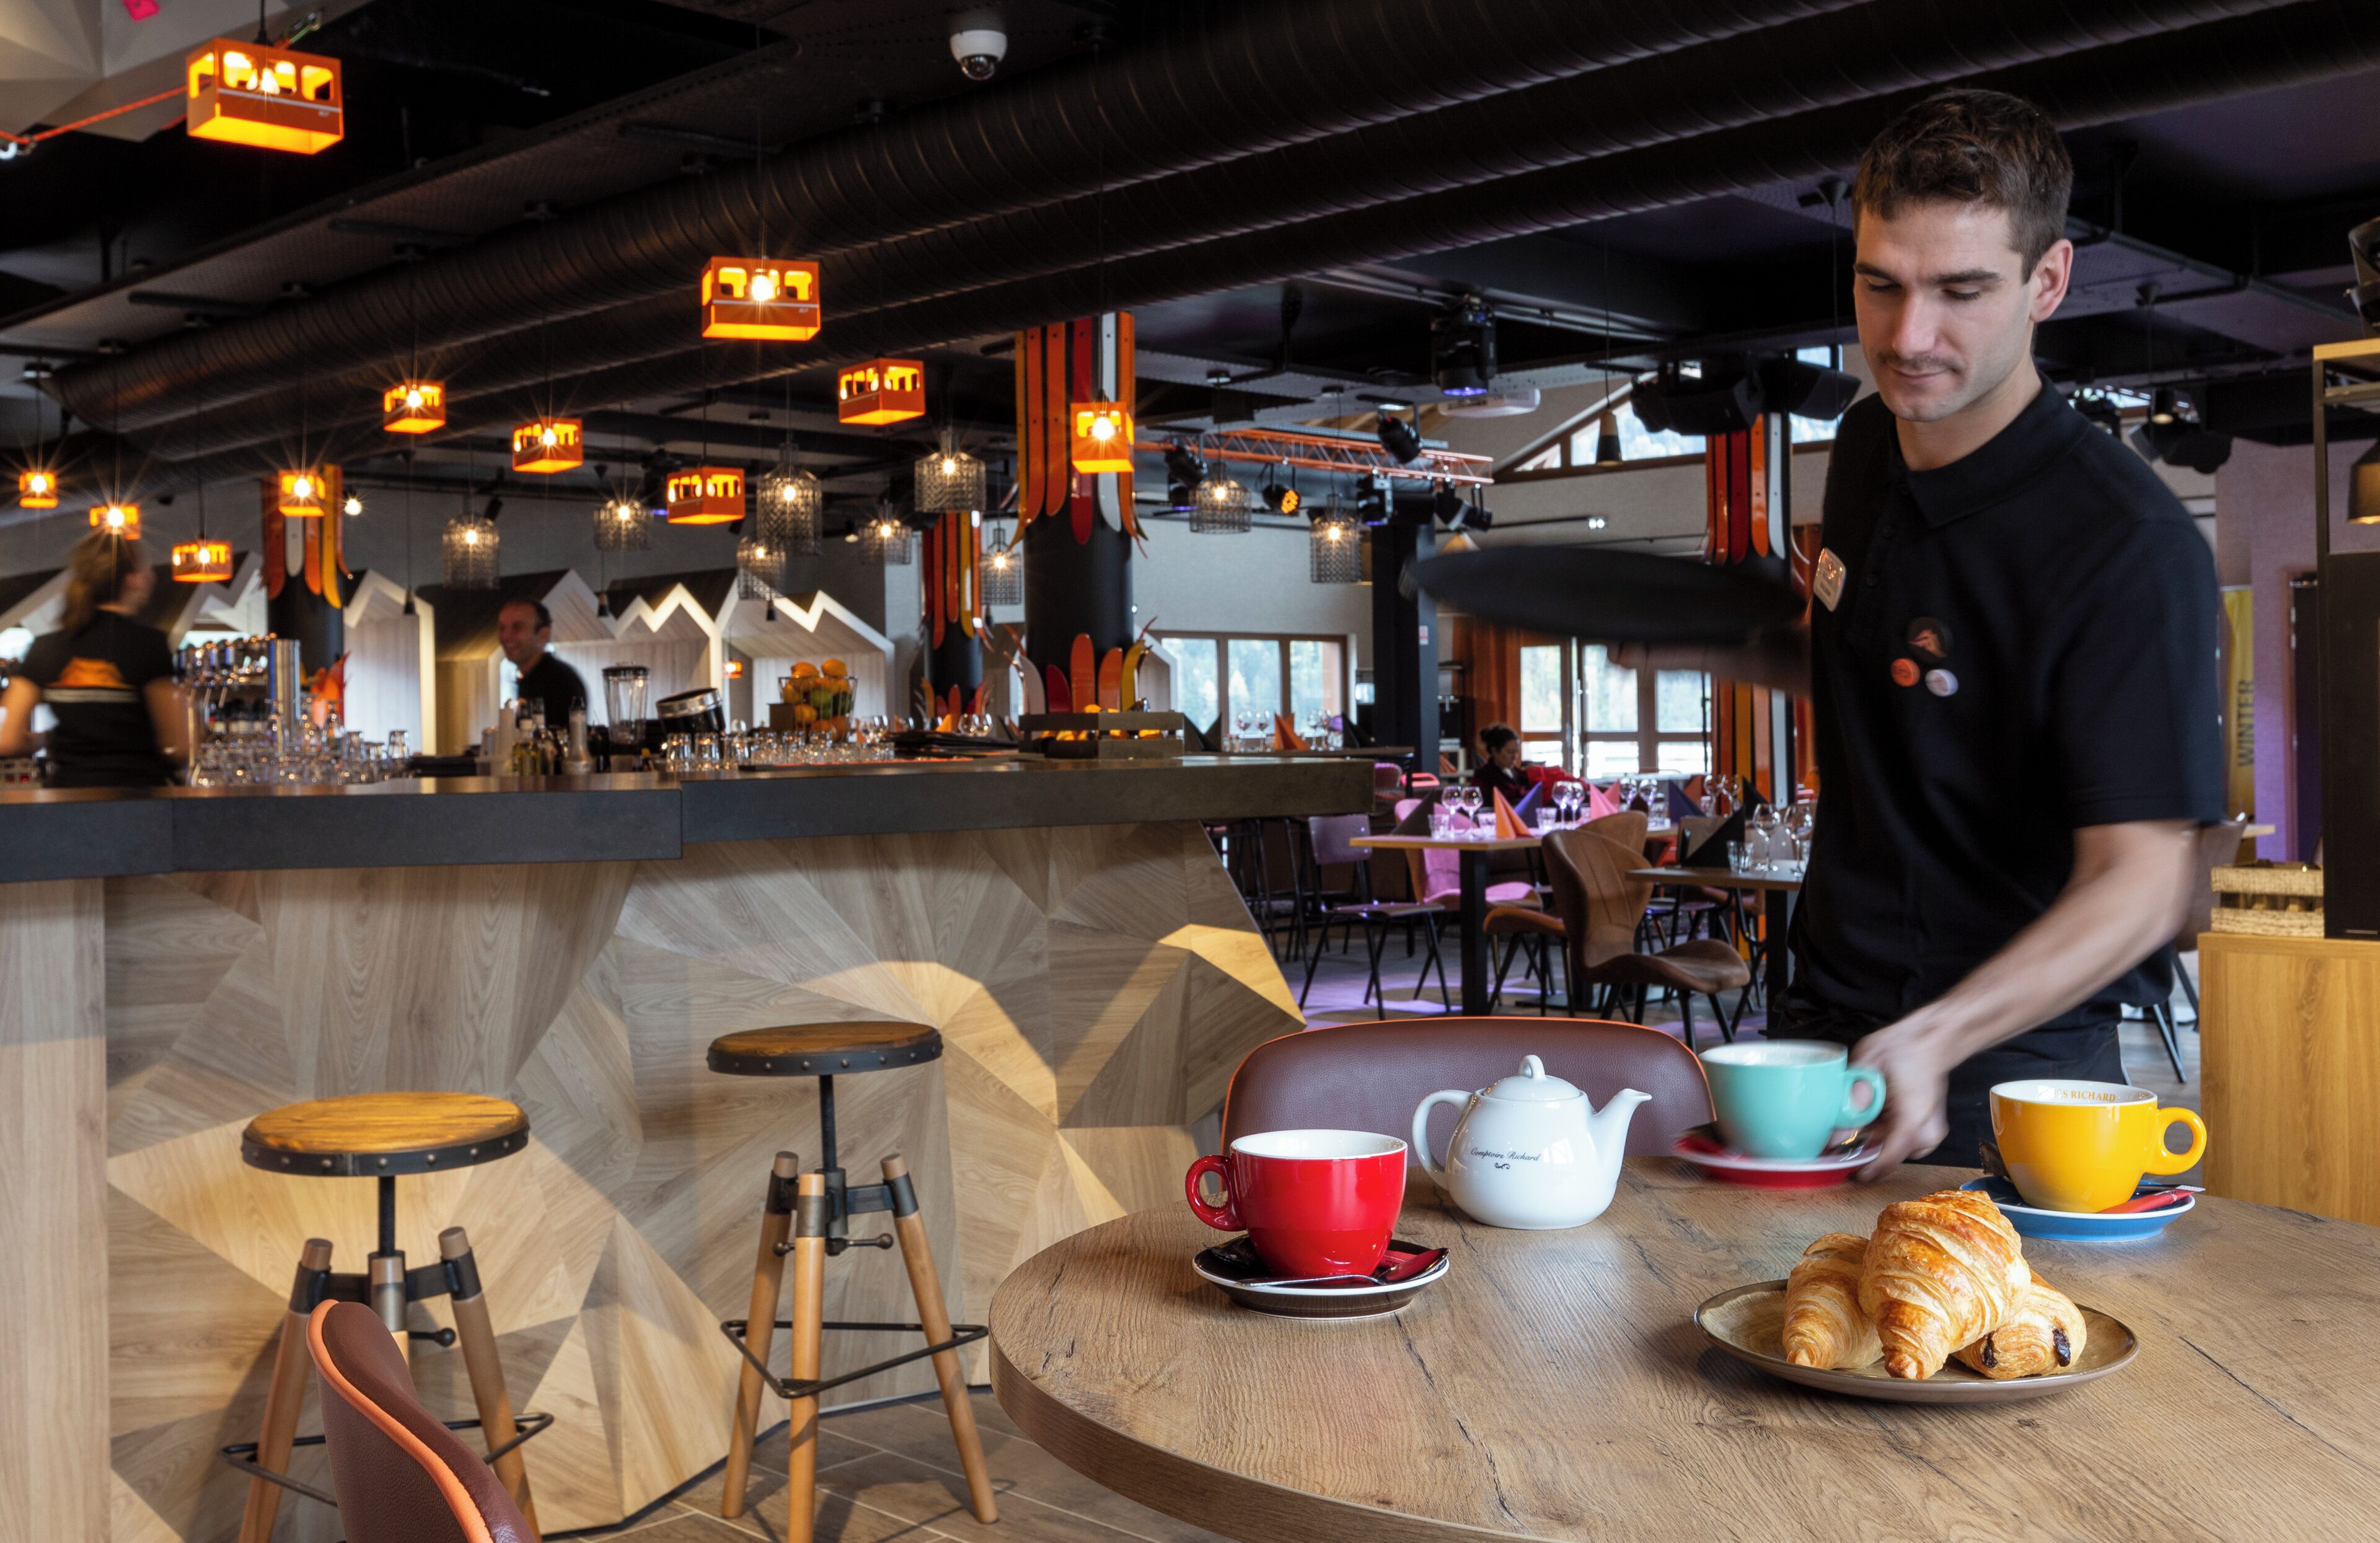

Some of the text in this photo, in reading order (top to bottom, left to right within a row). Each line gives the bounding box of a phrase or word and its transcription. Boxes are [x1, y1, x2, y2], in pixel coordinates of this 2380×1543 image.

[2071, 1090, 2116, 1102] RICHARD
[1471, 1147, 1541, 1161] Comptoirs Richard
